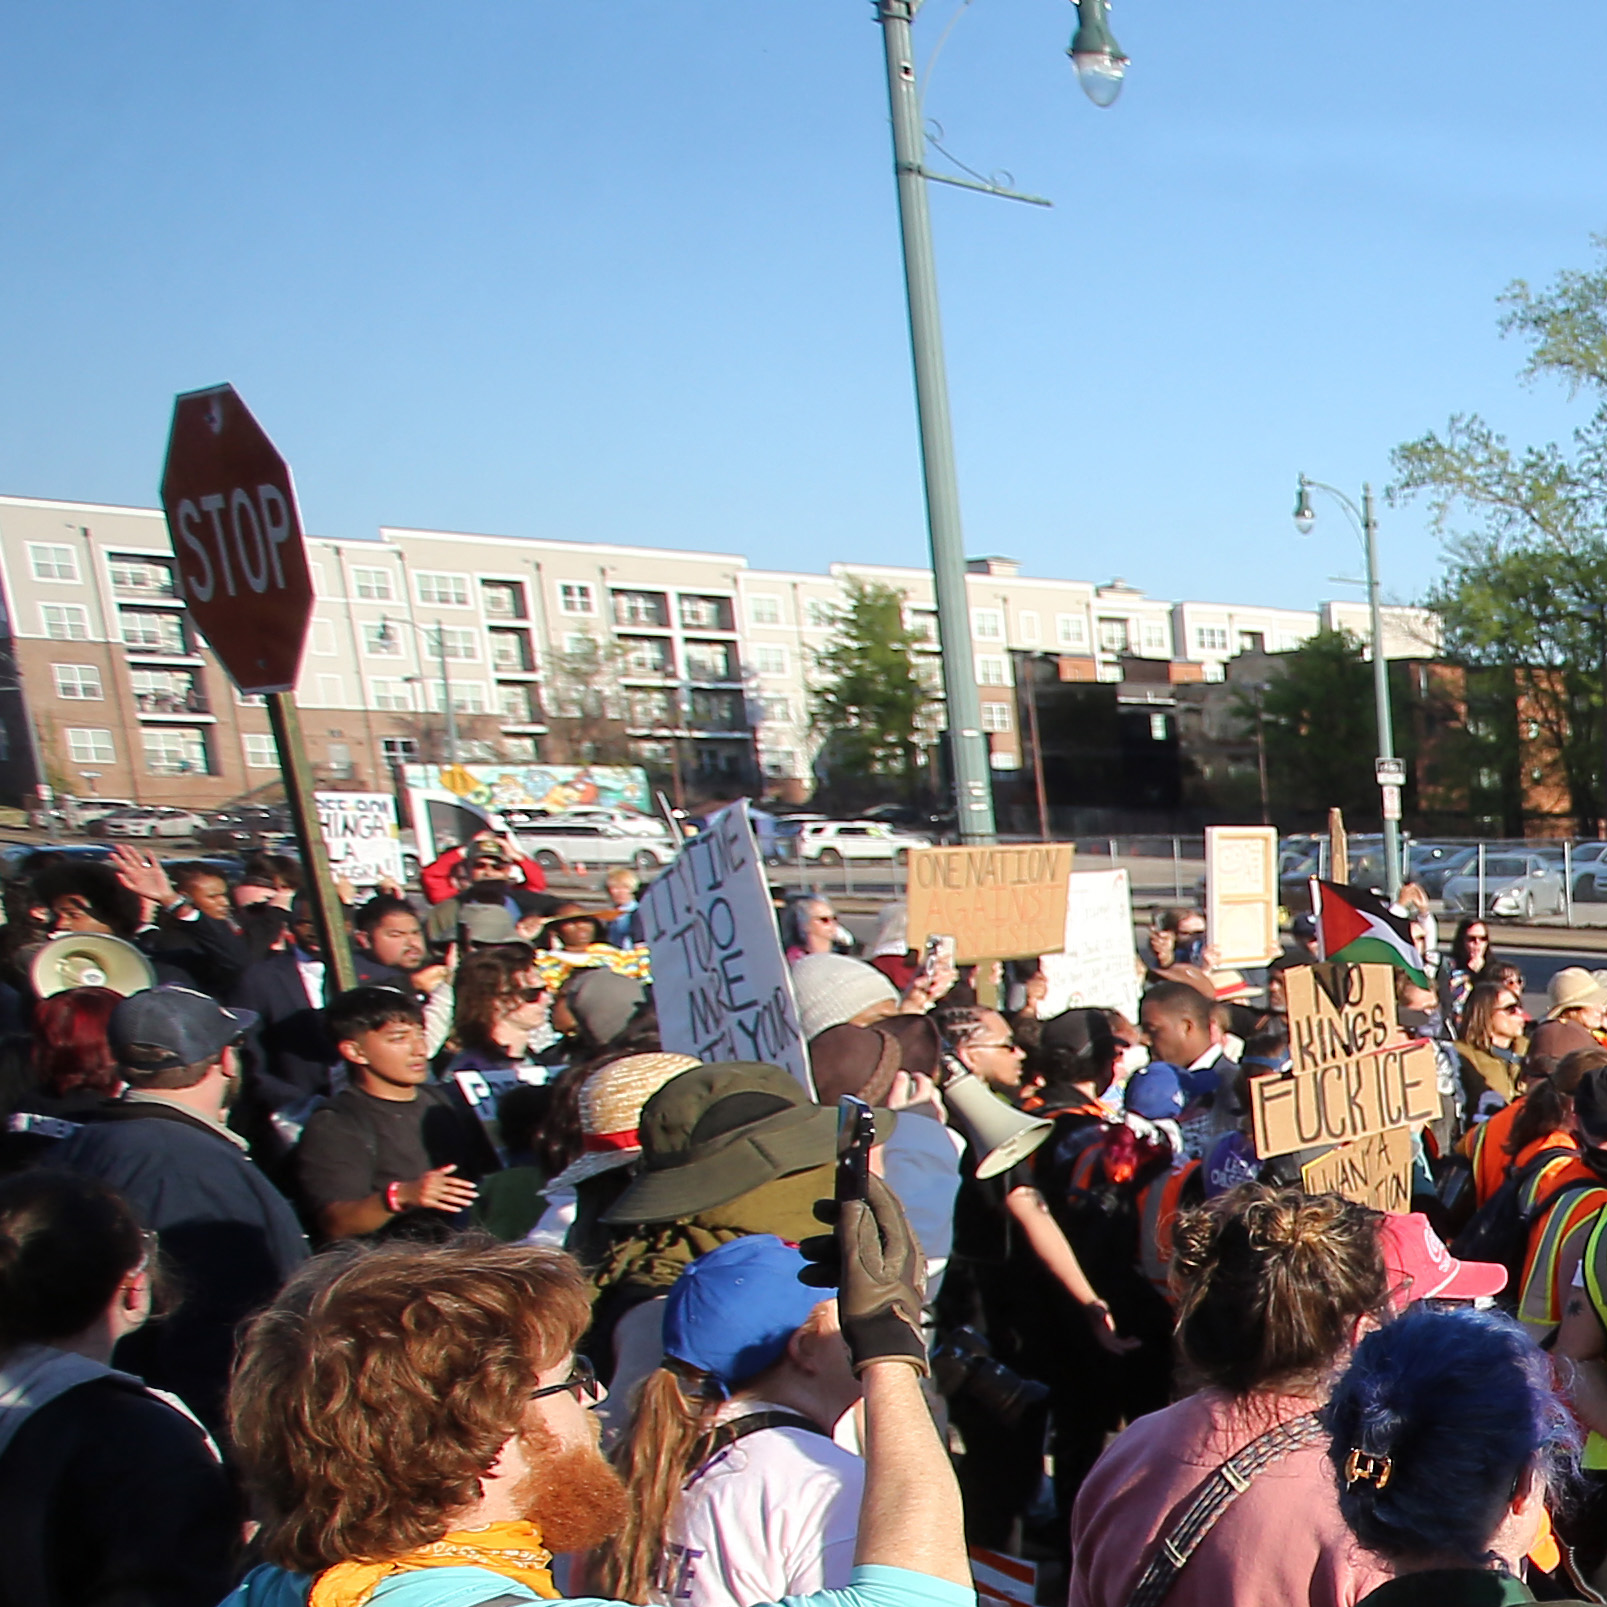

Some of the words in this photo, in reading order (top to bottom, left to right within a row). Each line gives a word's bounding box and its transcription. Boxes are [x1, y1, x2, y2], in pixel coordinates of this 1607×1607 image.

[177, 484, 291, 603] STOP
[916, 851, 962, 890] ONE
[965, 848, 1062, 887] NATION
[924, 883, 1066, 928] AGAINST
[1312, 964, 1364, 1016] NO
[1294, 1003, 1387, 1072] KINGS
[1259, 1060, 1367, 1153] FUCK
[1375, 1044, 1434, 1128] ICE
